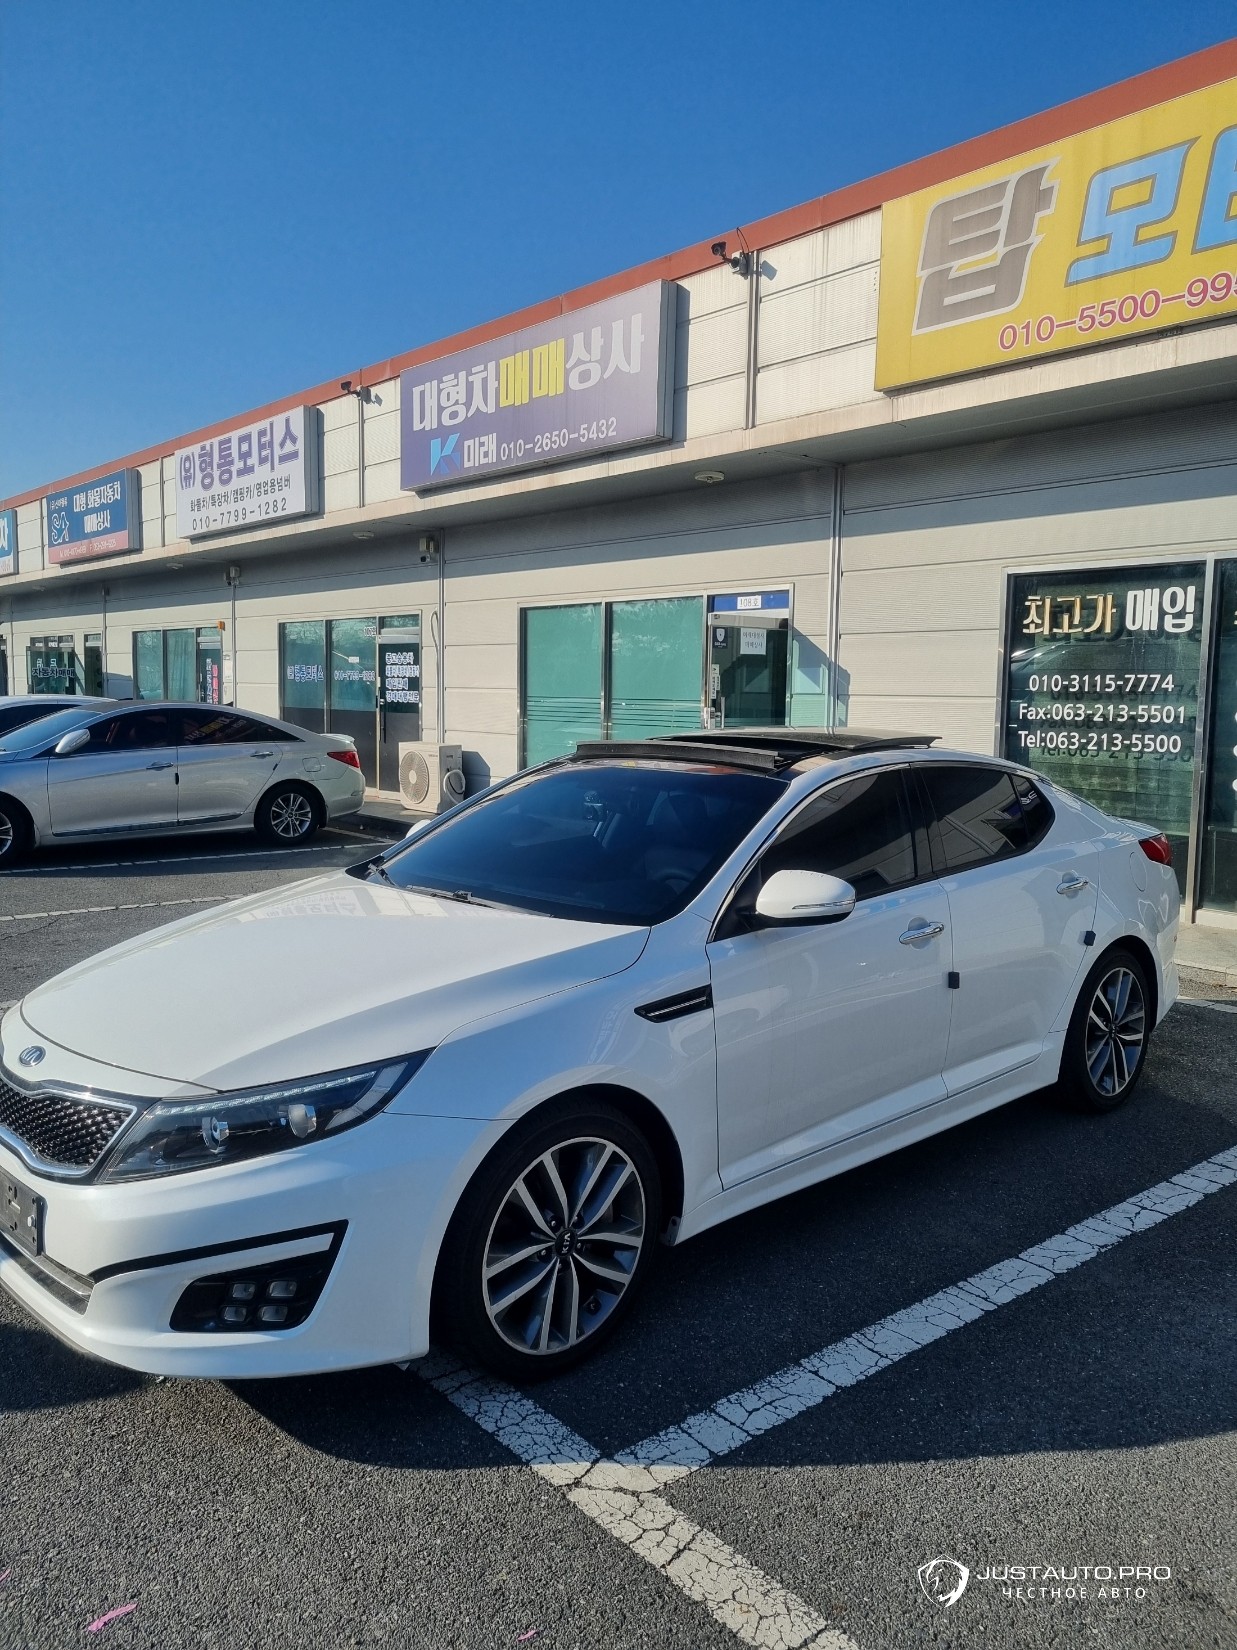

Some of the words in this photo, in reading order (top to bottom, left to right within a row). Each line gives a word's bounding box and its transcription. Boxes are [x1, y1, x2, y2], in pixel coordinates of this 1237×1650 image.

[998, 271, 1237, 352] 010-5500-99
[463, 433, 497, 468] 미래
[500, 417, 617, 461] 010-2650-5432
[73, 492, 86, 512] 대형
[87, 481, 121, 509] 화물자동차
[84, 509, 110, 533] 매매상사
[192, 498, 287, 530] 010-7799-1282
[739, 597, 759, 607] 108호
[1022, 592, 1117, 635] 최고가
[1125, 585, 1196, 633] 매입
[32, 667, 75, 678] 자동차매매
[1029, 673, 1174, 692] 010-3115-7774
[1019, 703, 1186, 724] Fax:063-213-5501
[1018, 730, 1182, 753] Tel:063-213-5500
